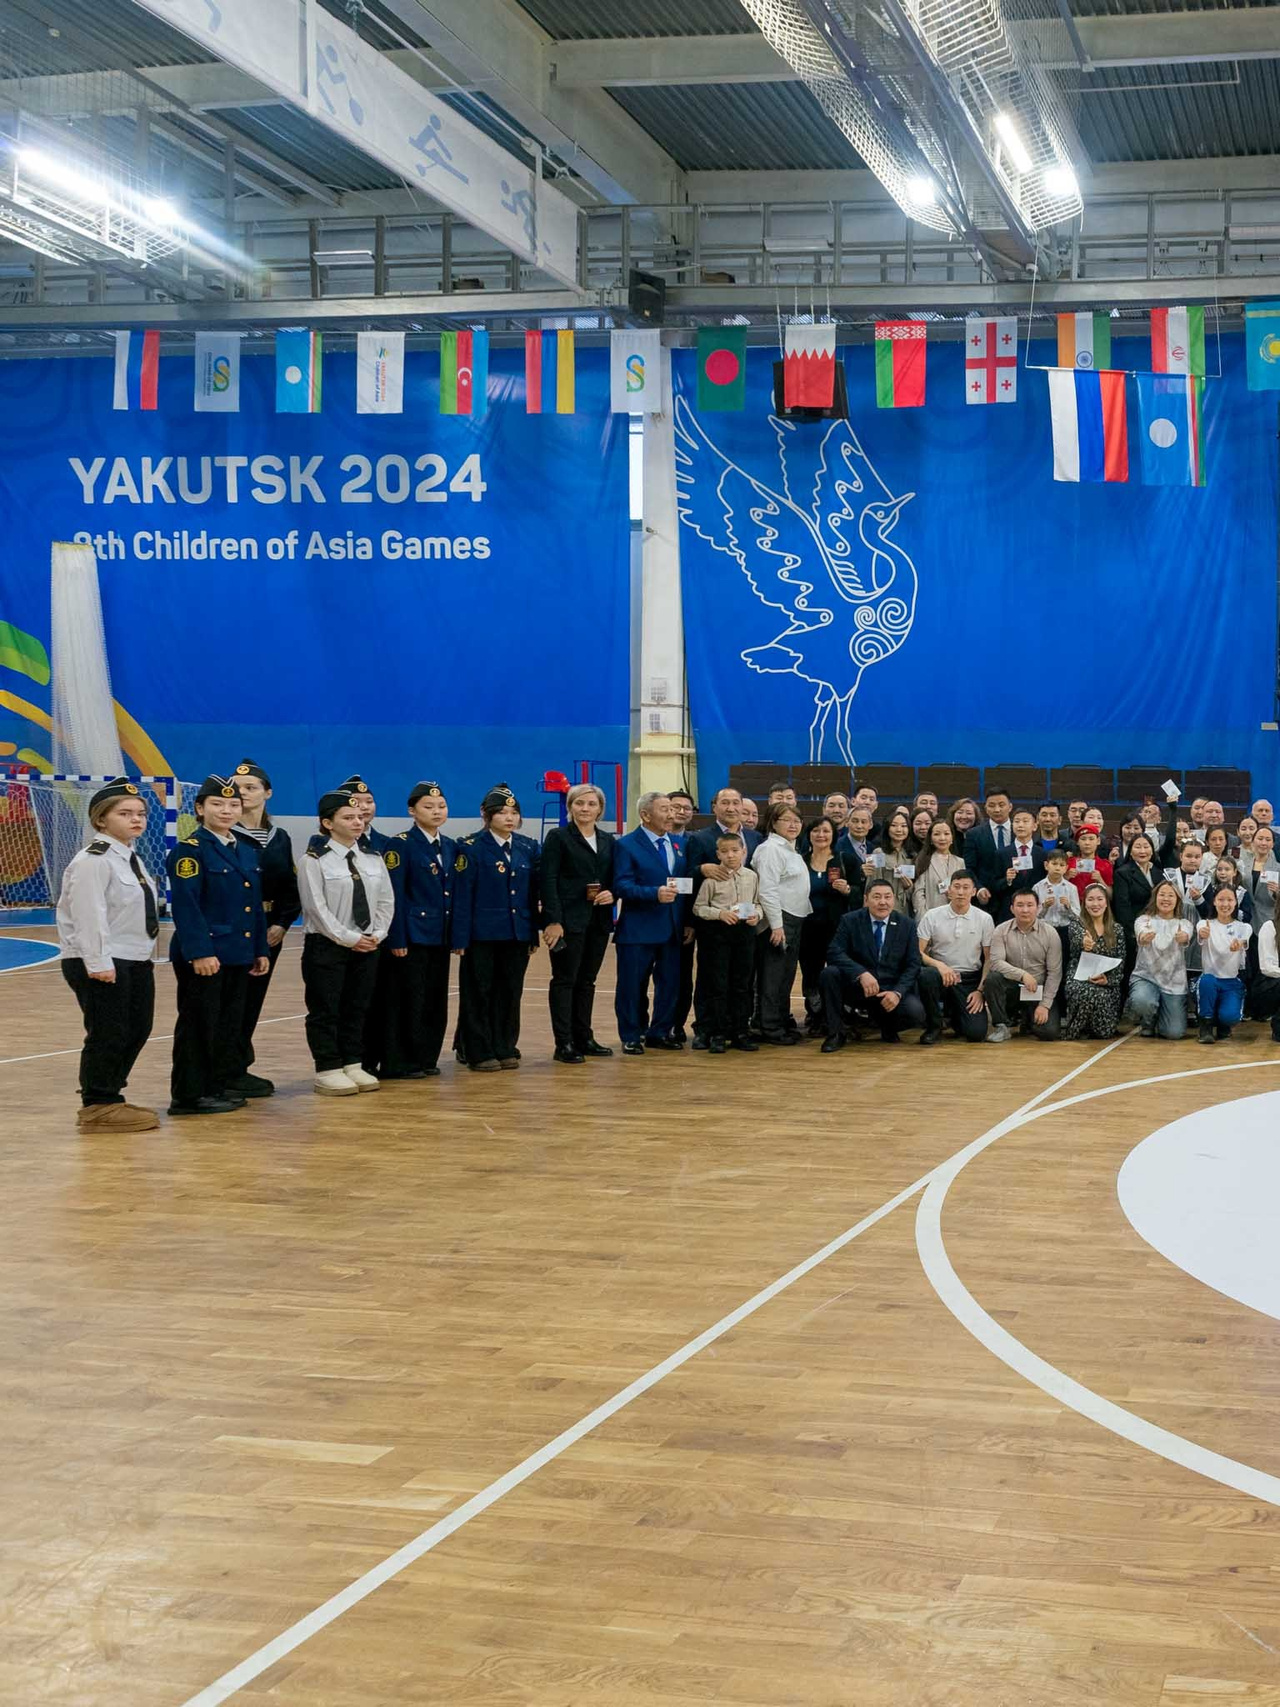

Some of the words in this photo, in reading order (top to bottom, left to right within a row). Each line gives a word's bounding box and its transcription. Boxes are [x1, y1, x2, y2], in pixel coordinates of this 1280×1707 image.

[68, 454, 327, 505] YAKUTSK
[339, 453, 488, 504] 2024
[132, 530, 259, 561] Children
[266, 529, 300, 561] of
[305, 529, 374, 561] Asia
[380, 533, 492, 561] Games
